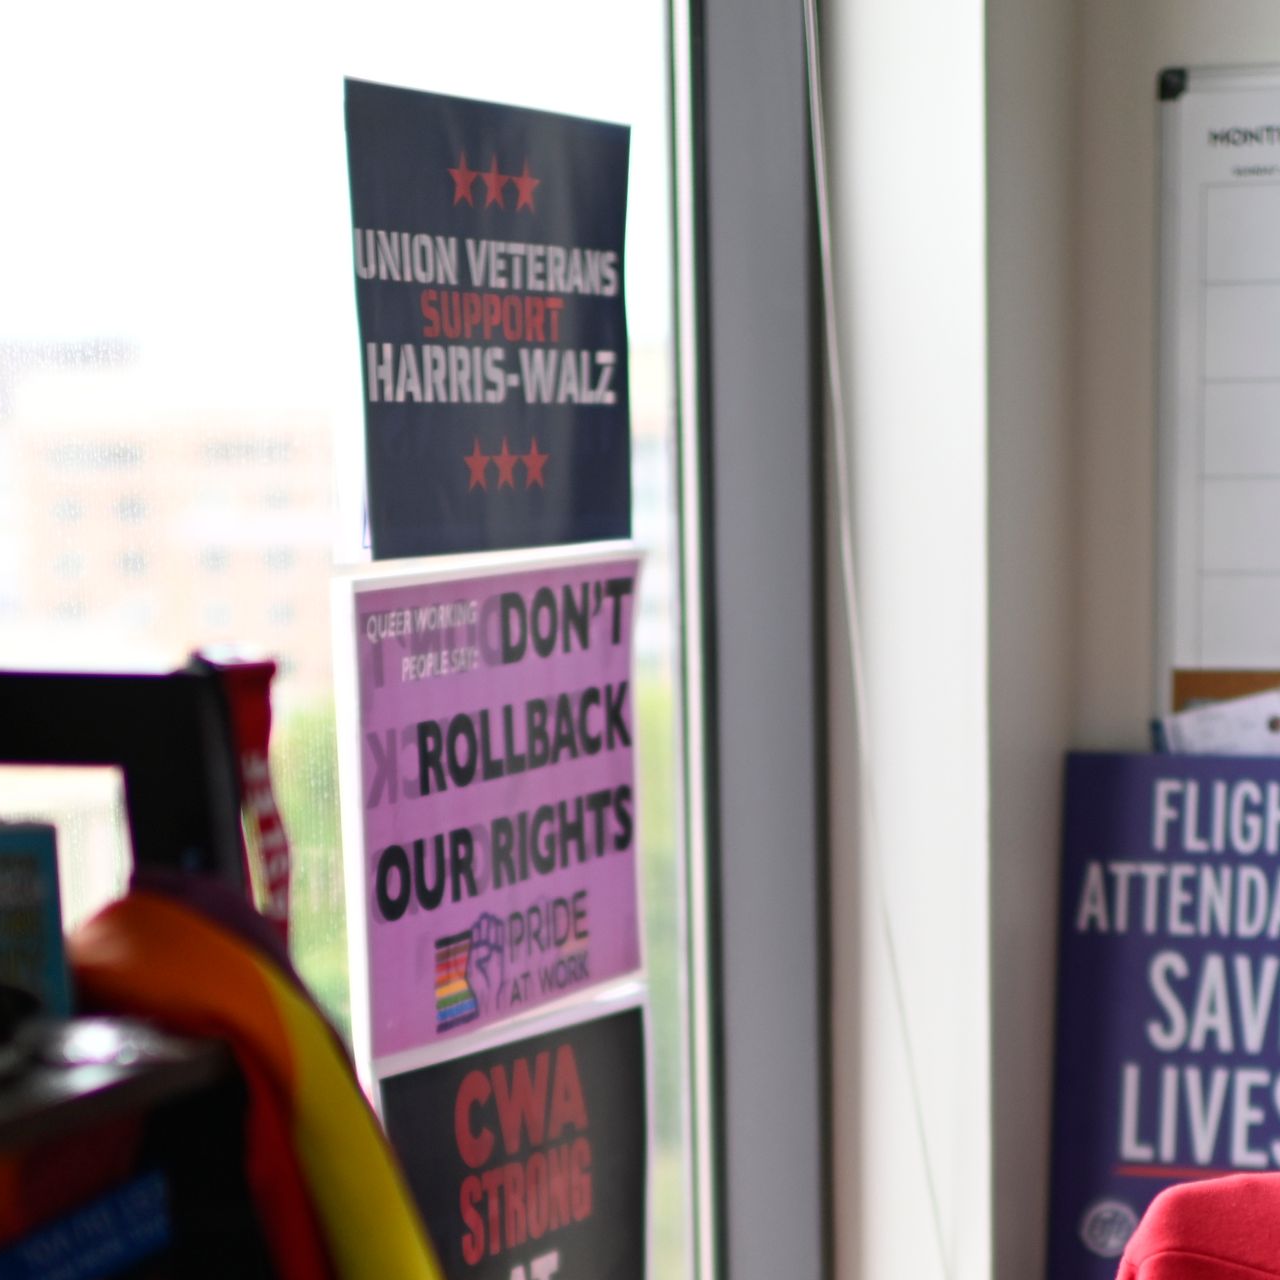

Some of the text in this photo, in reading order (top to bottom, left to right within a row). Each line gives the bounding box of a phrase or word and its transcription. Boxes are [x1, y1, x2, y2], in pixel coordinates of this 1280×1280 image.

[354, 228, 619, 297] UNION VETERANS
[420, 289, 565, 343] SUPPORT
[366, 342, 618, 405] HARRIS-WALZ
[366, 577, 632, 664] QUEER WORKING DON'T
[401, 646, 448, 682] PEOPLE
[416, 680, 632, 796] ROLLBACK
[376, 826, 477, 922] OUR
[489, 784, 633, 890] RIGHTS
[508, 890, 589, 963] PRIDE
[508, 951, 590, 1004] AT WORK
[454, 1043, 589, 1169] CWA
[459, 1137, 593, 1266] STRONG
